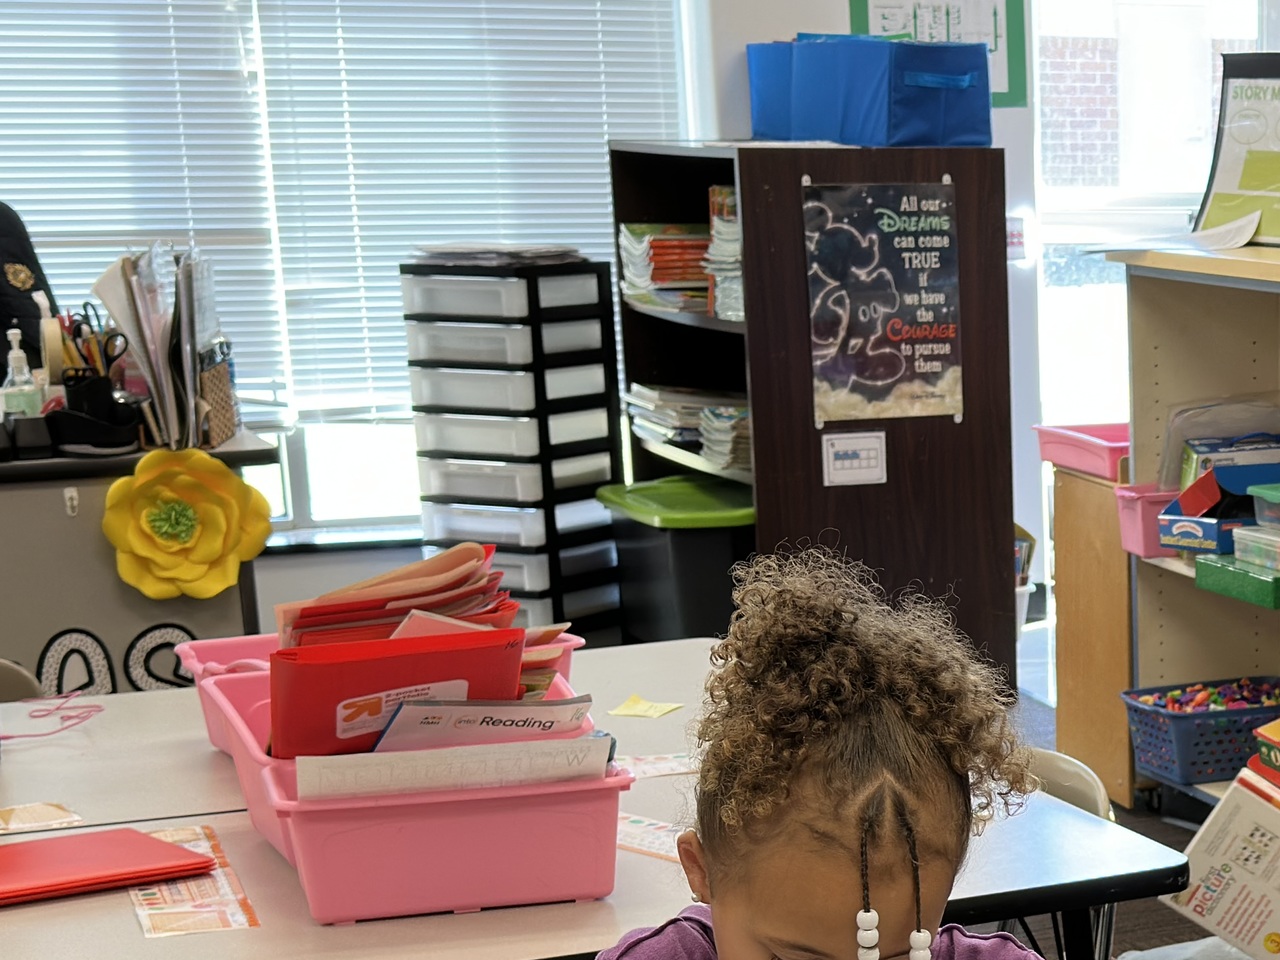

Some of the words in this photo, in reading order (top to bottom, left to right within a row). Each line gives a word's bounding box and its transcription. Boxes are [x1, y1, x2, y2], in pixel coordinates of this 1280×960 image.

[1232, 85, 1270, 100] STORY
[901, 196, 918, 211] All
[921, 199, 940, 211] our
[894, 236, 915, 248] can
[918, 236, 950, 248] come
[902, 252, 940, 268] TRUE
[918, 272, 928, 287] if
[904, 294, 919, 304] we
[921, 290, 945, 304] have
[917, 307, 934, 322] the
[901, 342, 912, 356] to
[914, 342, 950, 358] pursue
[914, 358, 942, 372] them
[479, 716, 554, 730] Reading
[1193, 863, 1232, 917] picture
